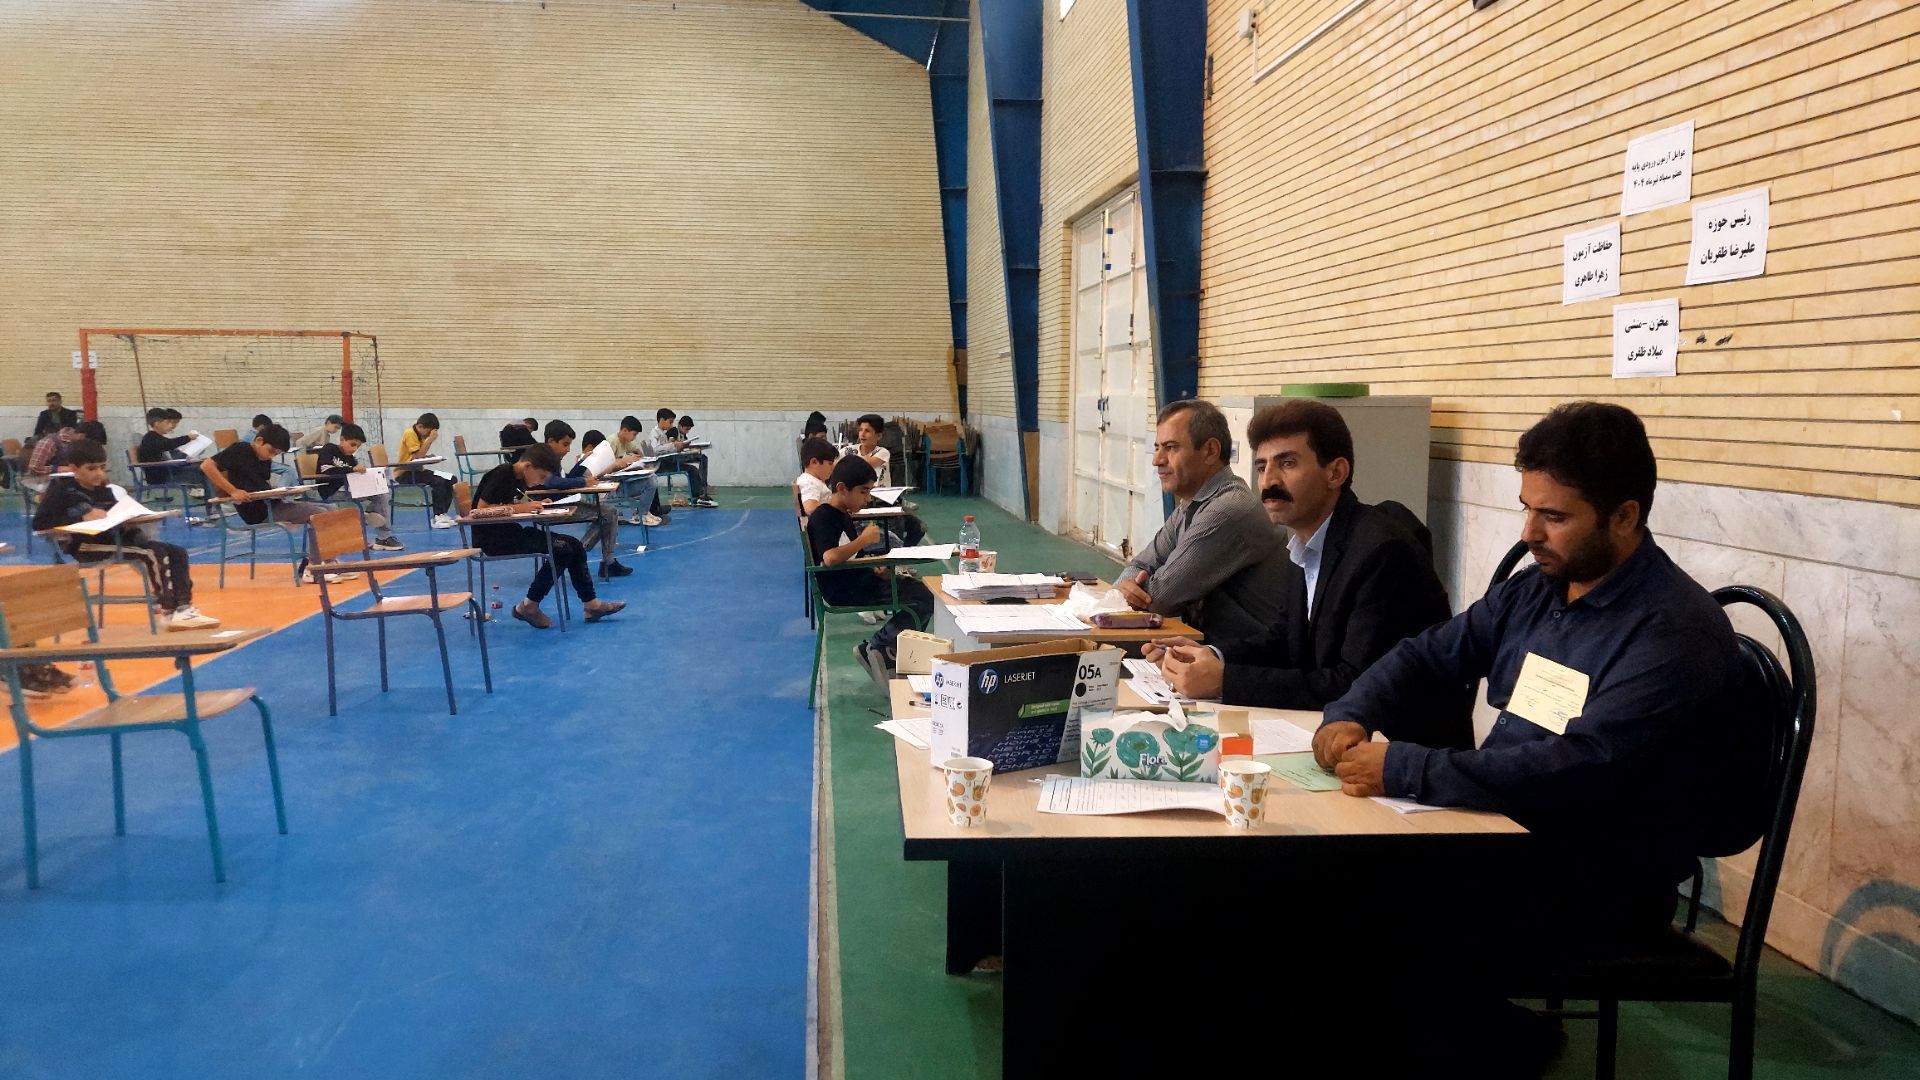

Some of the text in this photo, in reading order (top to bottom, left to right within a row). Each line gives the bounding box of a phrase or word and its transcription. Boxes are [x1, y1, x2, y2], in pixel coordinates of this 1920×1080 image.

[1641, 160, 1656, 171] ورودی
[1656, 151, 1671, 165] آزمون
[1708, 208, 1752, 233] رئیس حوزه
[1572, 240, 1613, 261] حفاظت آزمون
[1700, 240, 1756, 265] علیرضا ظفریان
[1594, 268, 1609, 283] زهرا
[1648, 315, 1669, 331] مخزن
[1627, 345, 1664, 361] میلاد ظفری
[1078, 664, 1102, 680] 05A
[980, 670, 1036, 695] hp LASERJET
[1139, 753, 1168, 766] Flora
